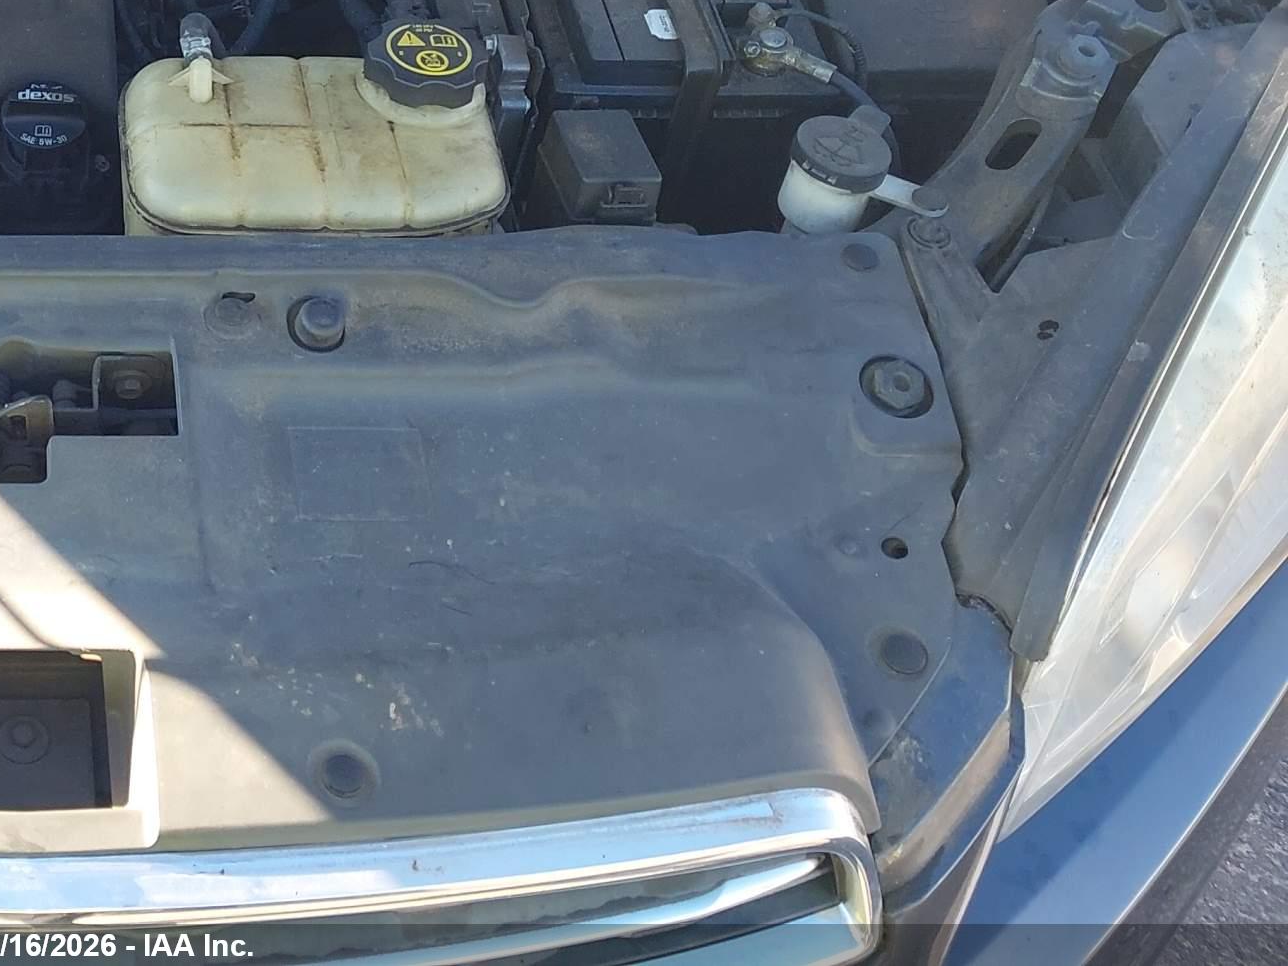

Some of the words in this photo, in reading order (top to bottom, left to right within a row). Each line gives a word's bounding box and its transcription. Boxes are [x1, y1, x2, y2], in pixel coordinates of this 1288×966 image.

[17, 89, 78, 103] dexos
[20, 132, 36, 145] SAE
[38, 134, 68, 146] 5W-30
